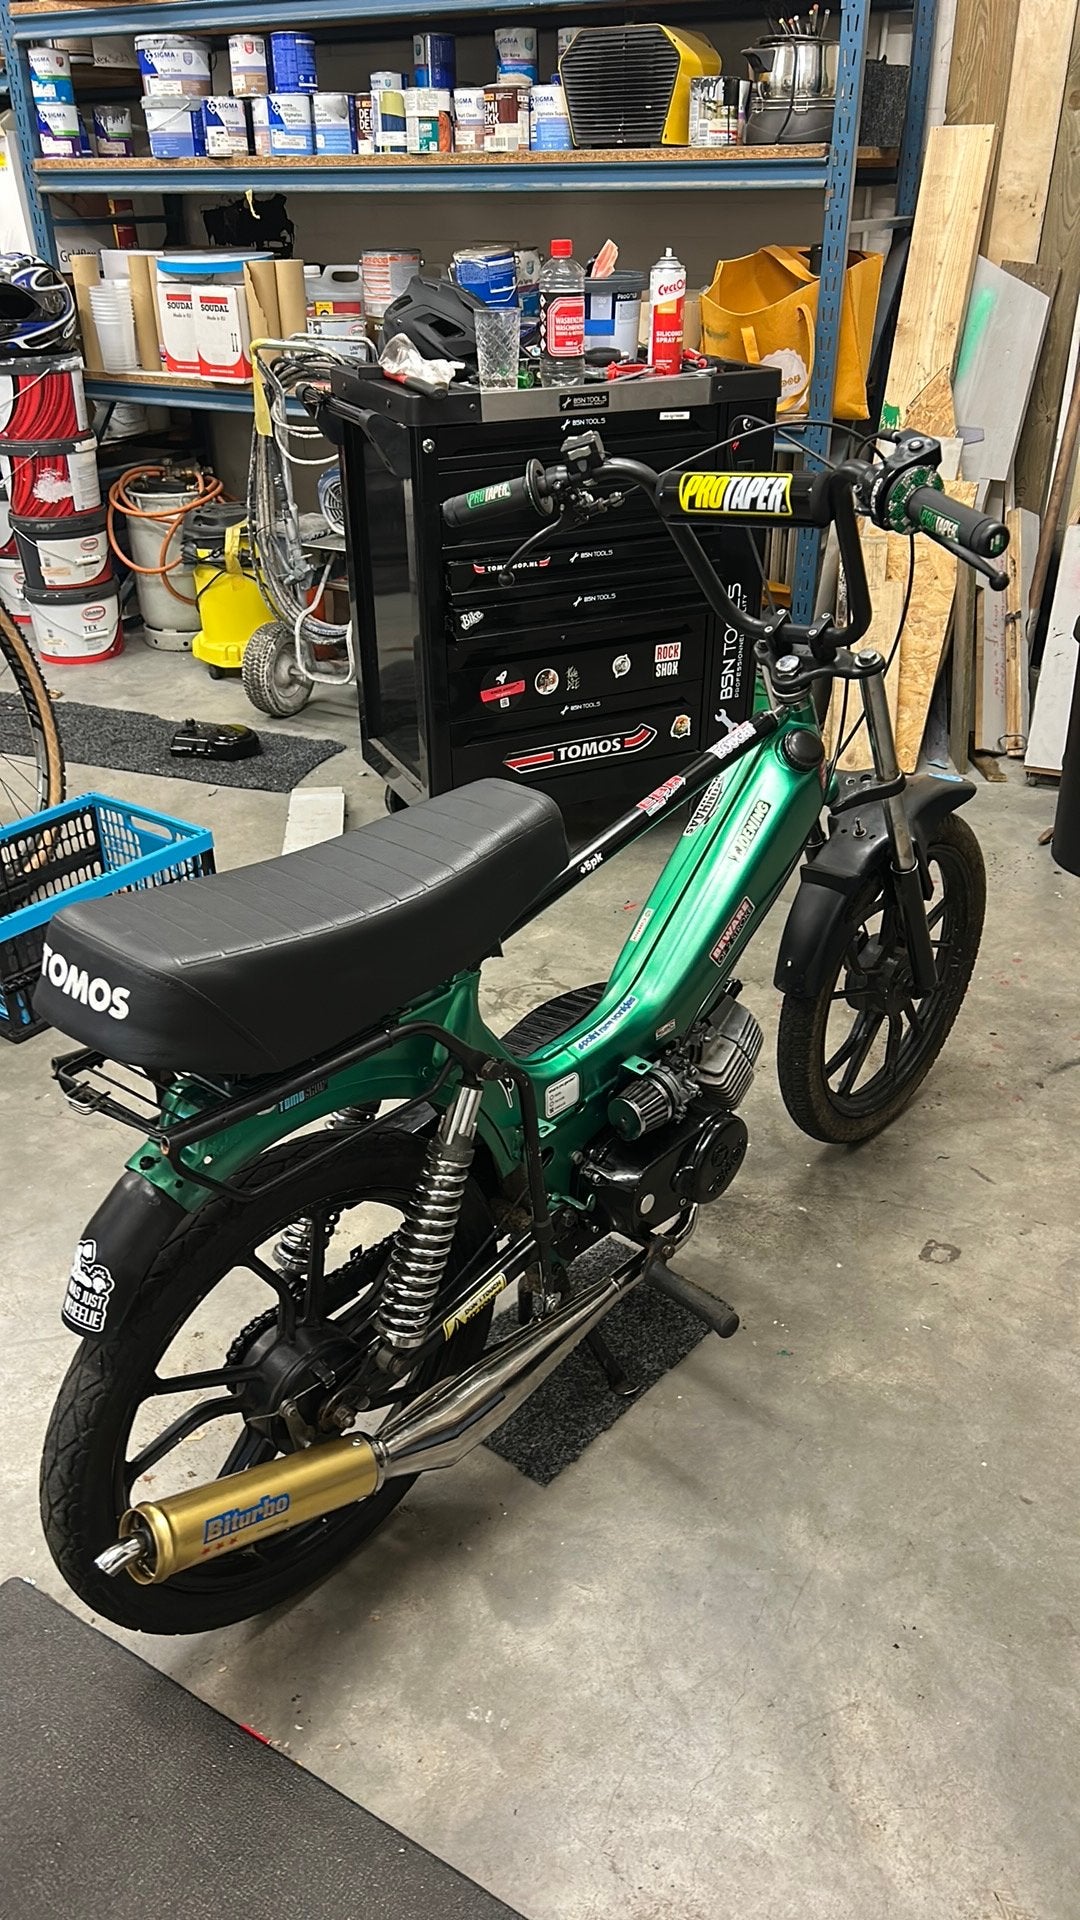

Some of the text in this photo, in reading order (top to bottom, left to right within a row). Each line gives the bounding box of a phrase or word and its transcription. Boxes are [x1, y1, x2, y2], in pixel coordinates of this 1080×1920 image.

[658, 279, 686, 296] CYCLO
[200, 304, 229, 313] SOUDAL
[573, 396, 586, 404] BSN
[587, 395, 607, 403] TOOLS
[585, 417, 606, 425] TOOLS
[470, 482, 510, 504] PROTAPER
[682, 475, 789, 513] PROTAPER
[580, 549, 613, 559] BSN TOOLS
[583, 592, 617, 602] BSN TOOLS
[84, 624, 98, 632] TEX
[657, 644, 680, 660] ROCK
[655, 661, 679, 678] SHOX
[720, 658, 737, 700] BSN
[570, 701, 601, 711] BSN TOOLS
[557, 737, 621, 761] TOMOS
[41, 942, 130, 1020] TOMOS
[80, 1290, 105, 1310] JUST
[204, 1493, 290, 1545] Biturbo
